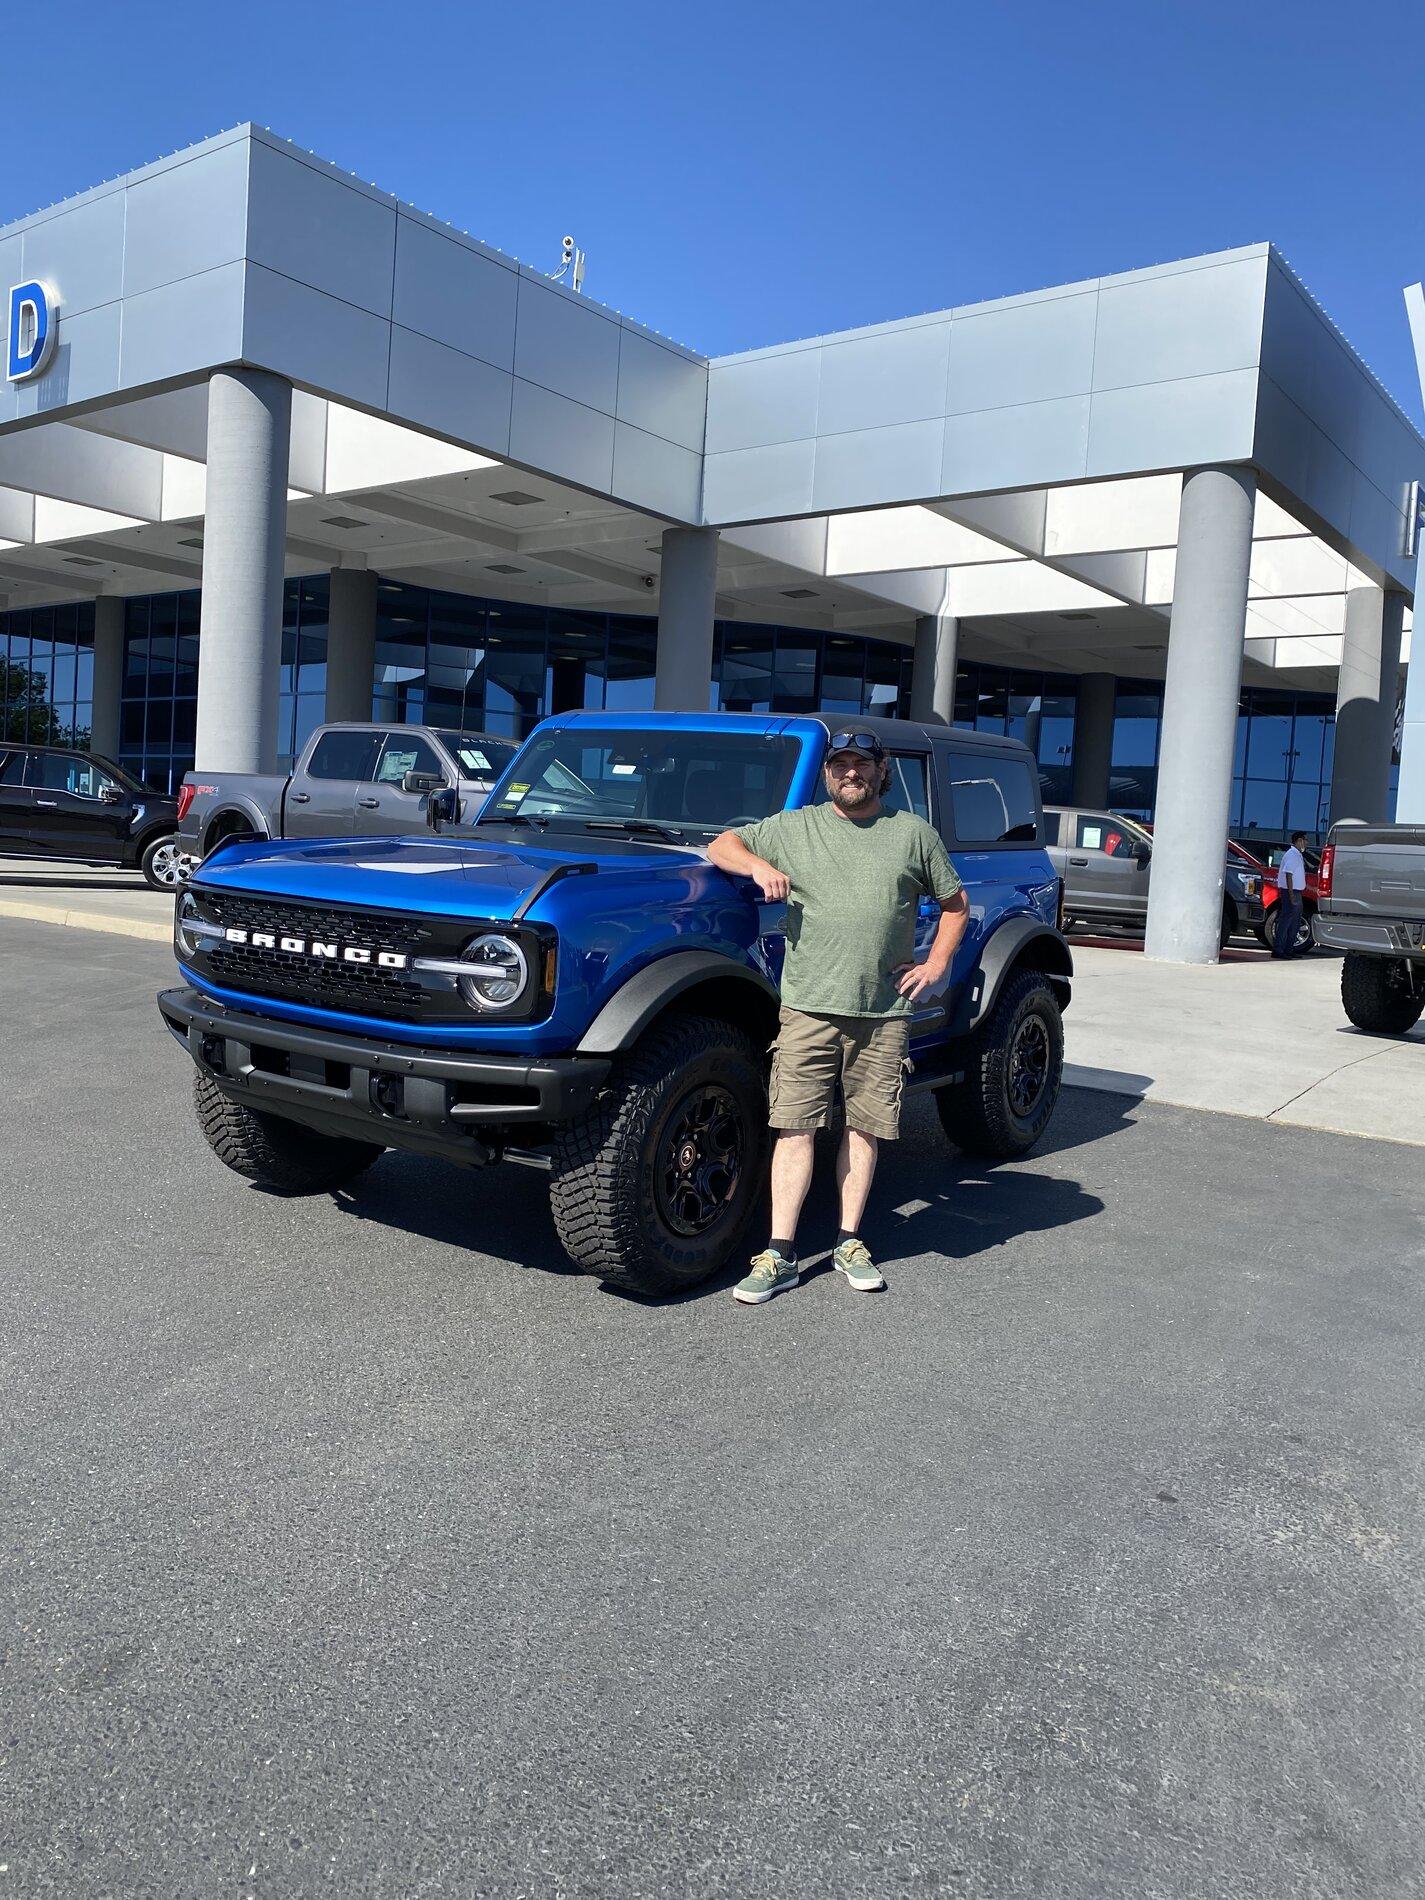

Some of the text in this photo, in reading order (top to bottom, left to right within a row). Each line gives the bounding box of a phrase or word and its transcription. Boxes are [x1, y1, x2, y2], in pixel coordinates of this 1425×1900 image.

[6, 279, 57, 383] D
[197, 785, 220, 796] FX4
[225, 928, 407, 968] BRONCO
